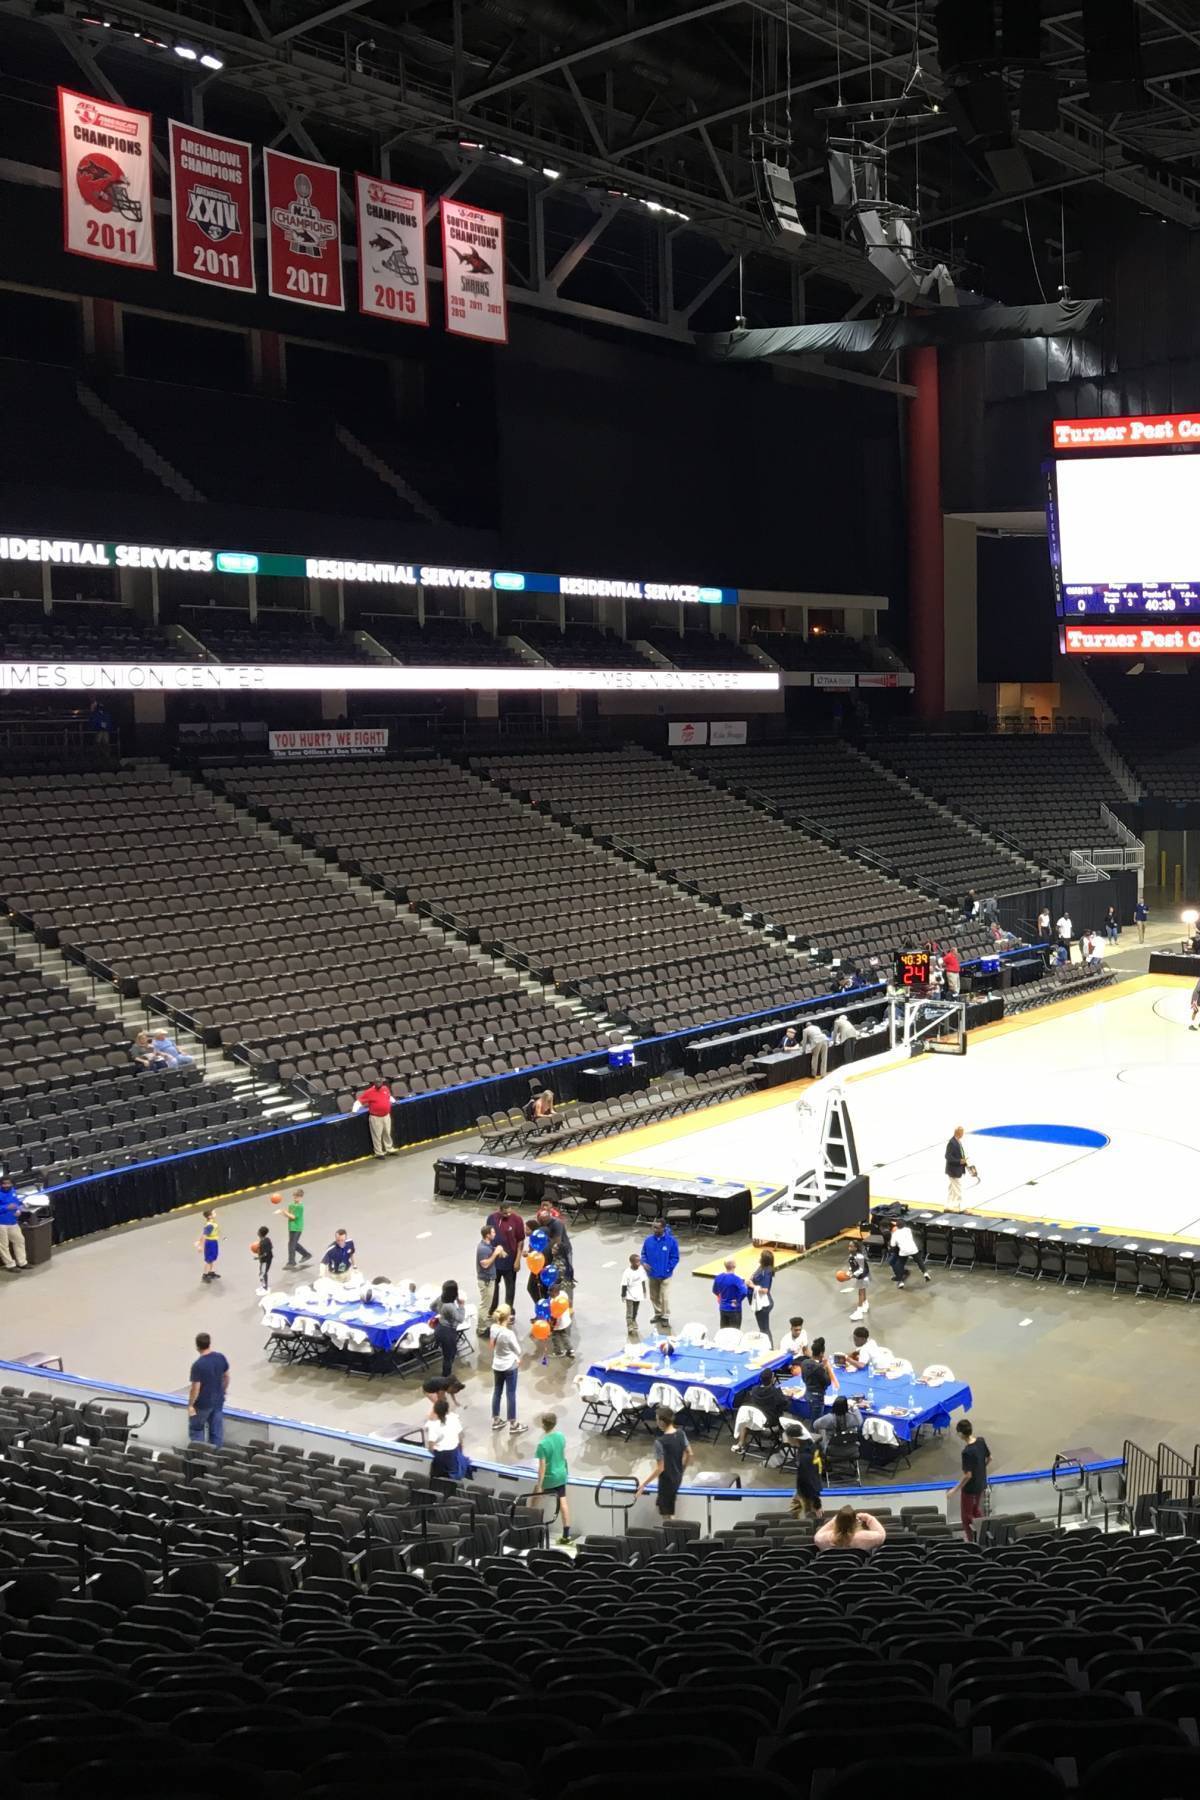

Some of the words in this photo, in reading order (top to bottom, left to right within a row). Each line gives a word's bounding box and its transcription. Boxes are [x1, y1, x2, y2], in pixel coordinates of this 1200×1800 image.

[74, 125, 142, 156] CHAMPIONS
[181, 138, 241, 168] ARENABOWL
[181, 155, 242, 185] CHAMPIONS
[189, 193, 236, 230] XXIV
[276, 212, 333, 235] CHAMPIONS
[366, 203, 417, 228] CHAMPIONS
[87, 220, 137, 254] 2011
[446, 214, 469, 230] SOUTH
[470, 221, 499, 238] DIVISION
[450, 227, 497, 250] CHAMPIONS
[193, 246, 240, 279] 2011
[286, 266, 328, 297] 2017
[461, 275, 490, 297] SHARKS
[374, 284, 416, 314] 2015
[1055, 425, 1127, 443] Turner
[1130, 421, 1174, 440] Pest
[0, 537, 110, 565] IDENTIAL
[115, 545, 213, 572] SERVICES
[305, 559, 417, 584] RESIDENTIAL
[420, 567, 492, 588] SERVICES
[559, 578, 643, 599] RESIDENTIAL
[644, 583, 700, 602] SERVICES
[1077, 599, 1086, 612] 0
[1108, 604, 1116, 614] 0
[1068, 630, 1138, 648] Turner
[1141, 630, 1184, 647] Pest
[80, 666, 164, 687] UNION
[175, 667, 266, 688] CENTER
[274, 733, 296, 748] YOU
[300, 732, 332, 747] HURT?
[336, 731, 351, 746] WE
[355, 731, 385, 745] FIGHT!
[901, 954, 928, 965] 40:39
[904, 966, 925, 984] 24
